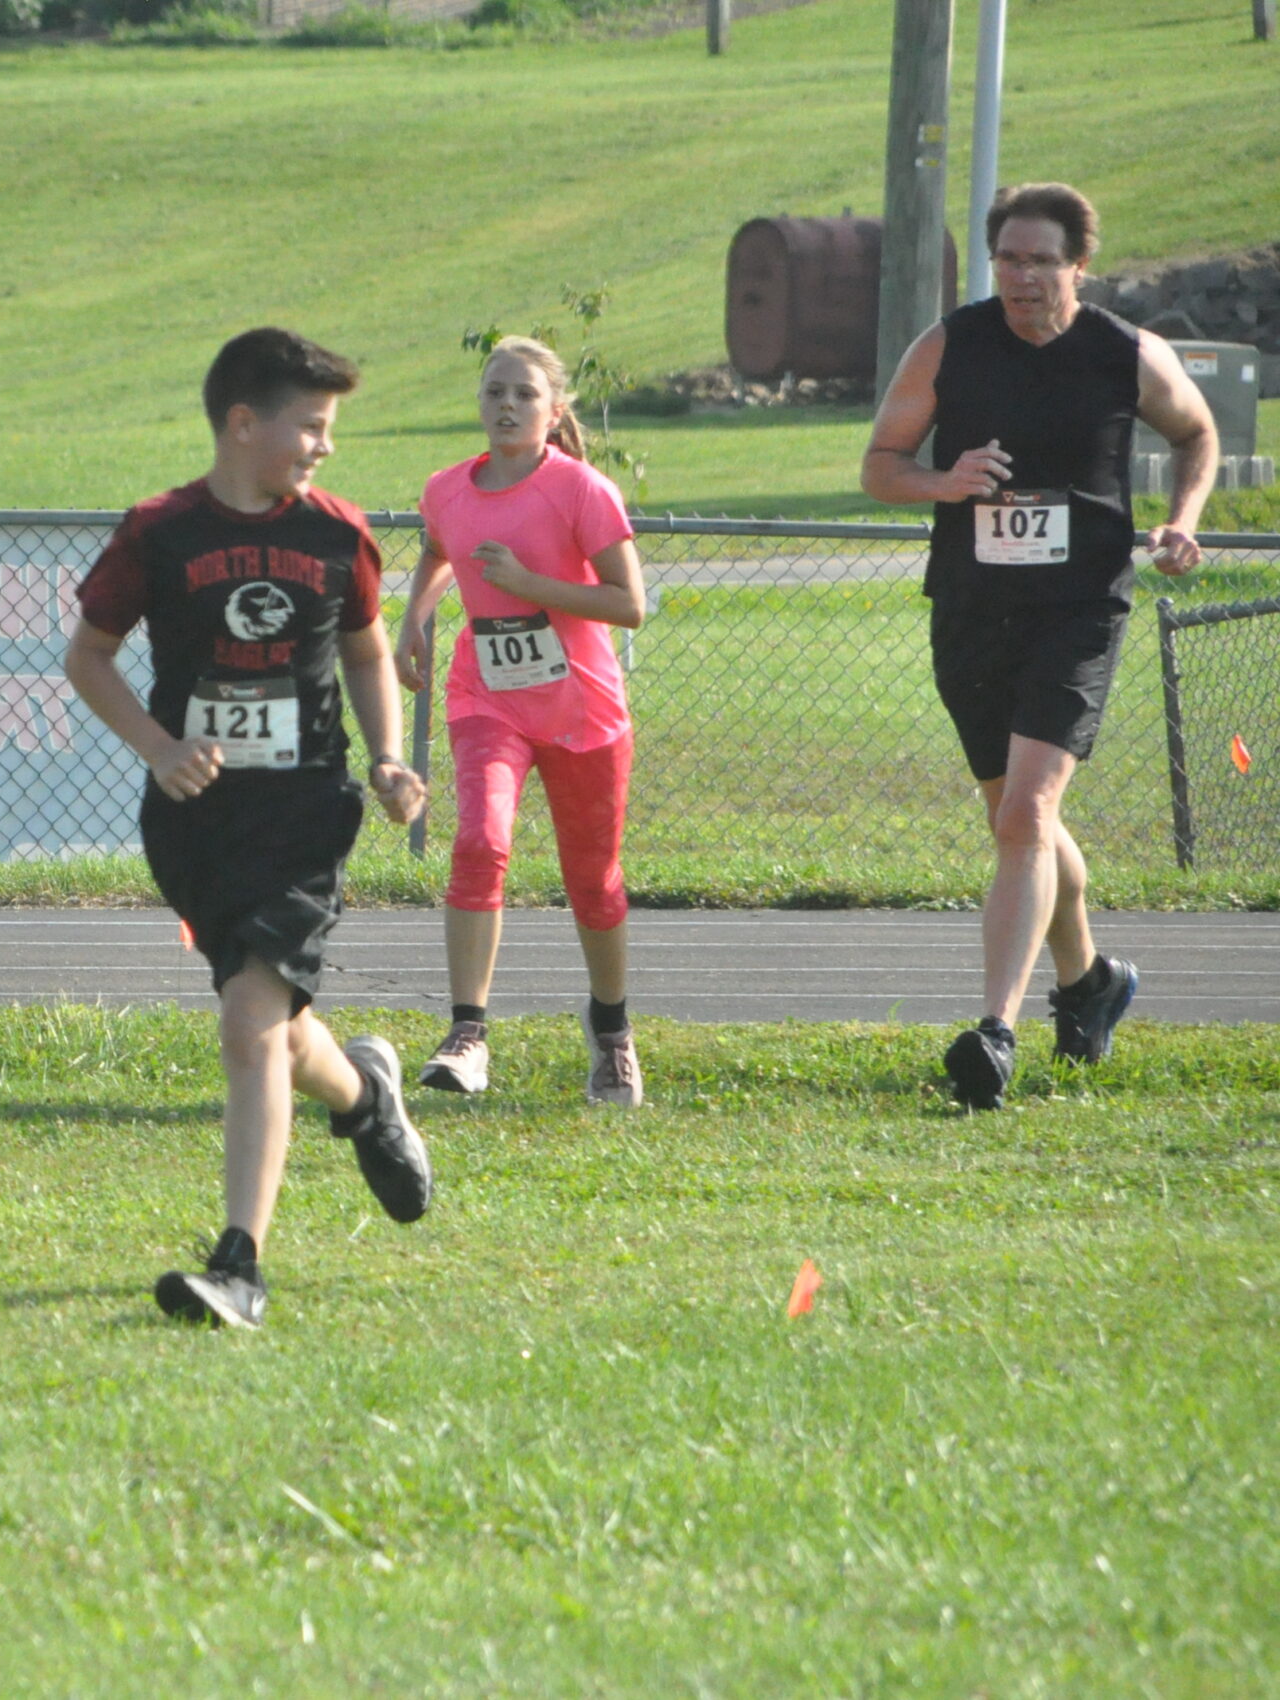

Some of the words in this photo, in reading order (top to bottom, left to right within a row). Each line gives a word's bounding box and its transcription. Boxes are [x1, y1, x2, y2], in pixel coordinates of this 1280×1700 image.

[991, 508, 1051, 539] 107
[488, 632, 544, 667] 101
[202, 704, 273, 739] 121
